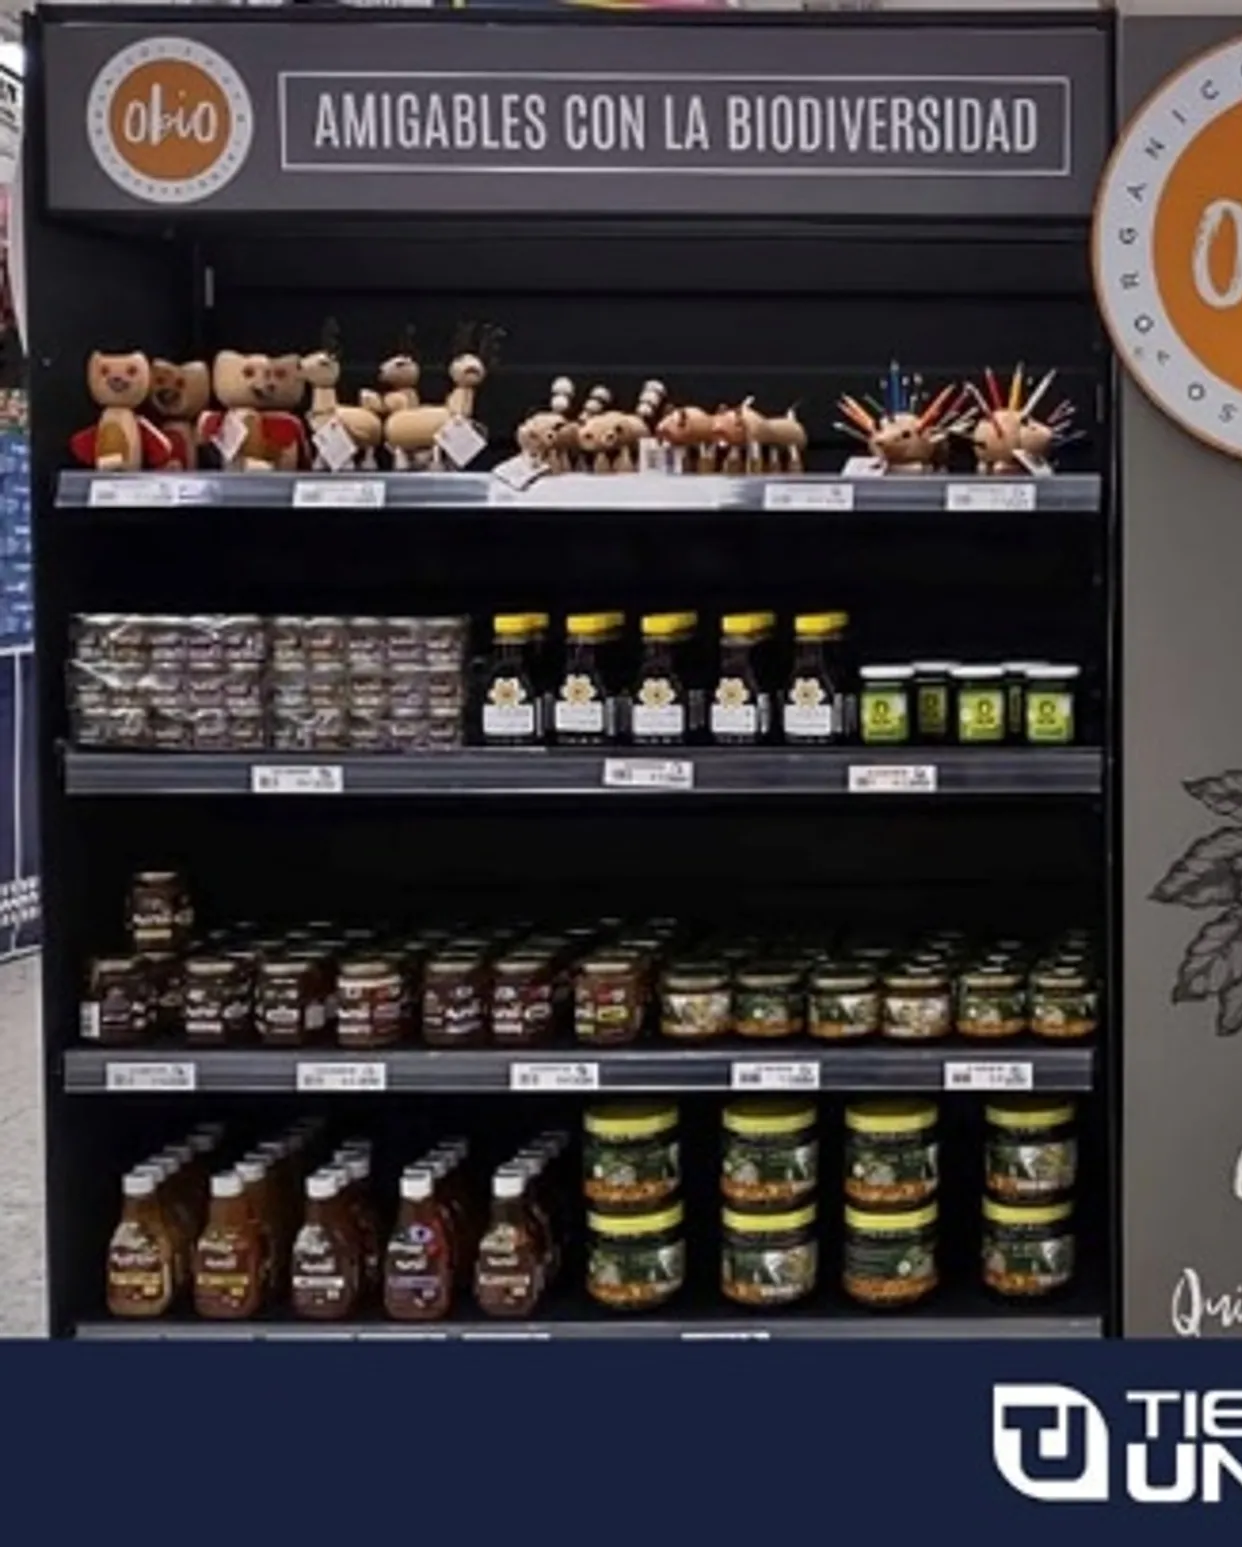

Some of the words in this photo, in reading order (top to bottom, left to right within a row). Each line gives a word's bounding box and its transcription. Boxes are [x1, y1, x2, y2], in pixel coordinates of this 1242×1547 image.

[124, 82, 218, 146] obio
[314, 93, 547, 149] AMIGABLES
[565, 94, 646, 151] CON
[665, 95, 709, 150] LA
[727, 95, 1038, 153] BIODIVERSIDAD
